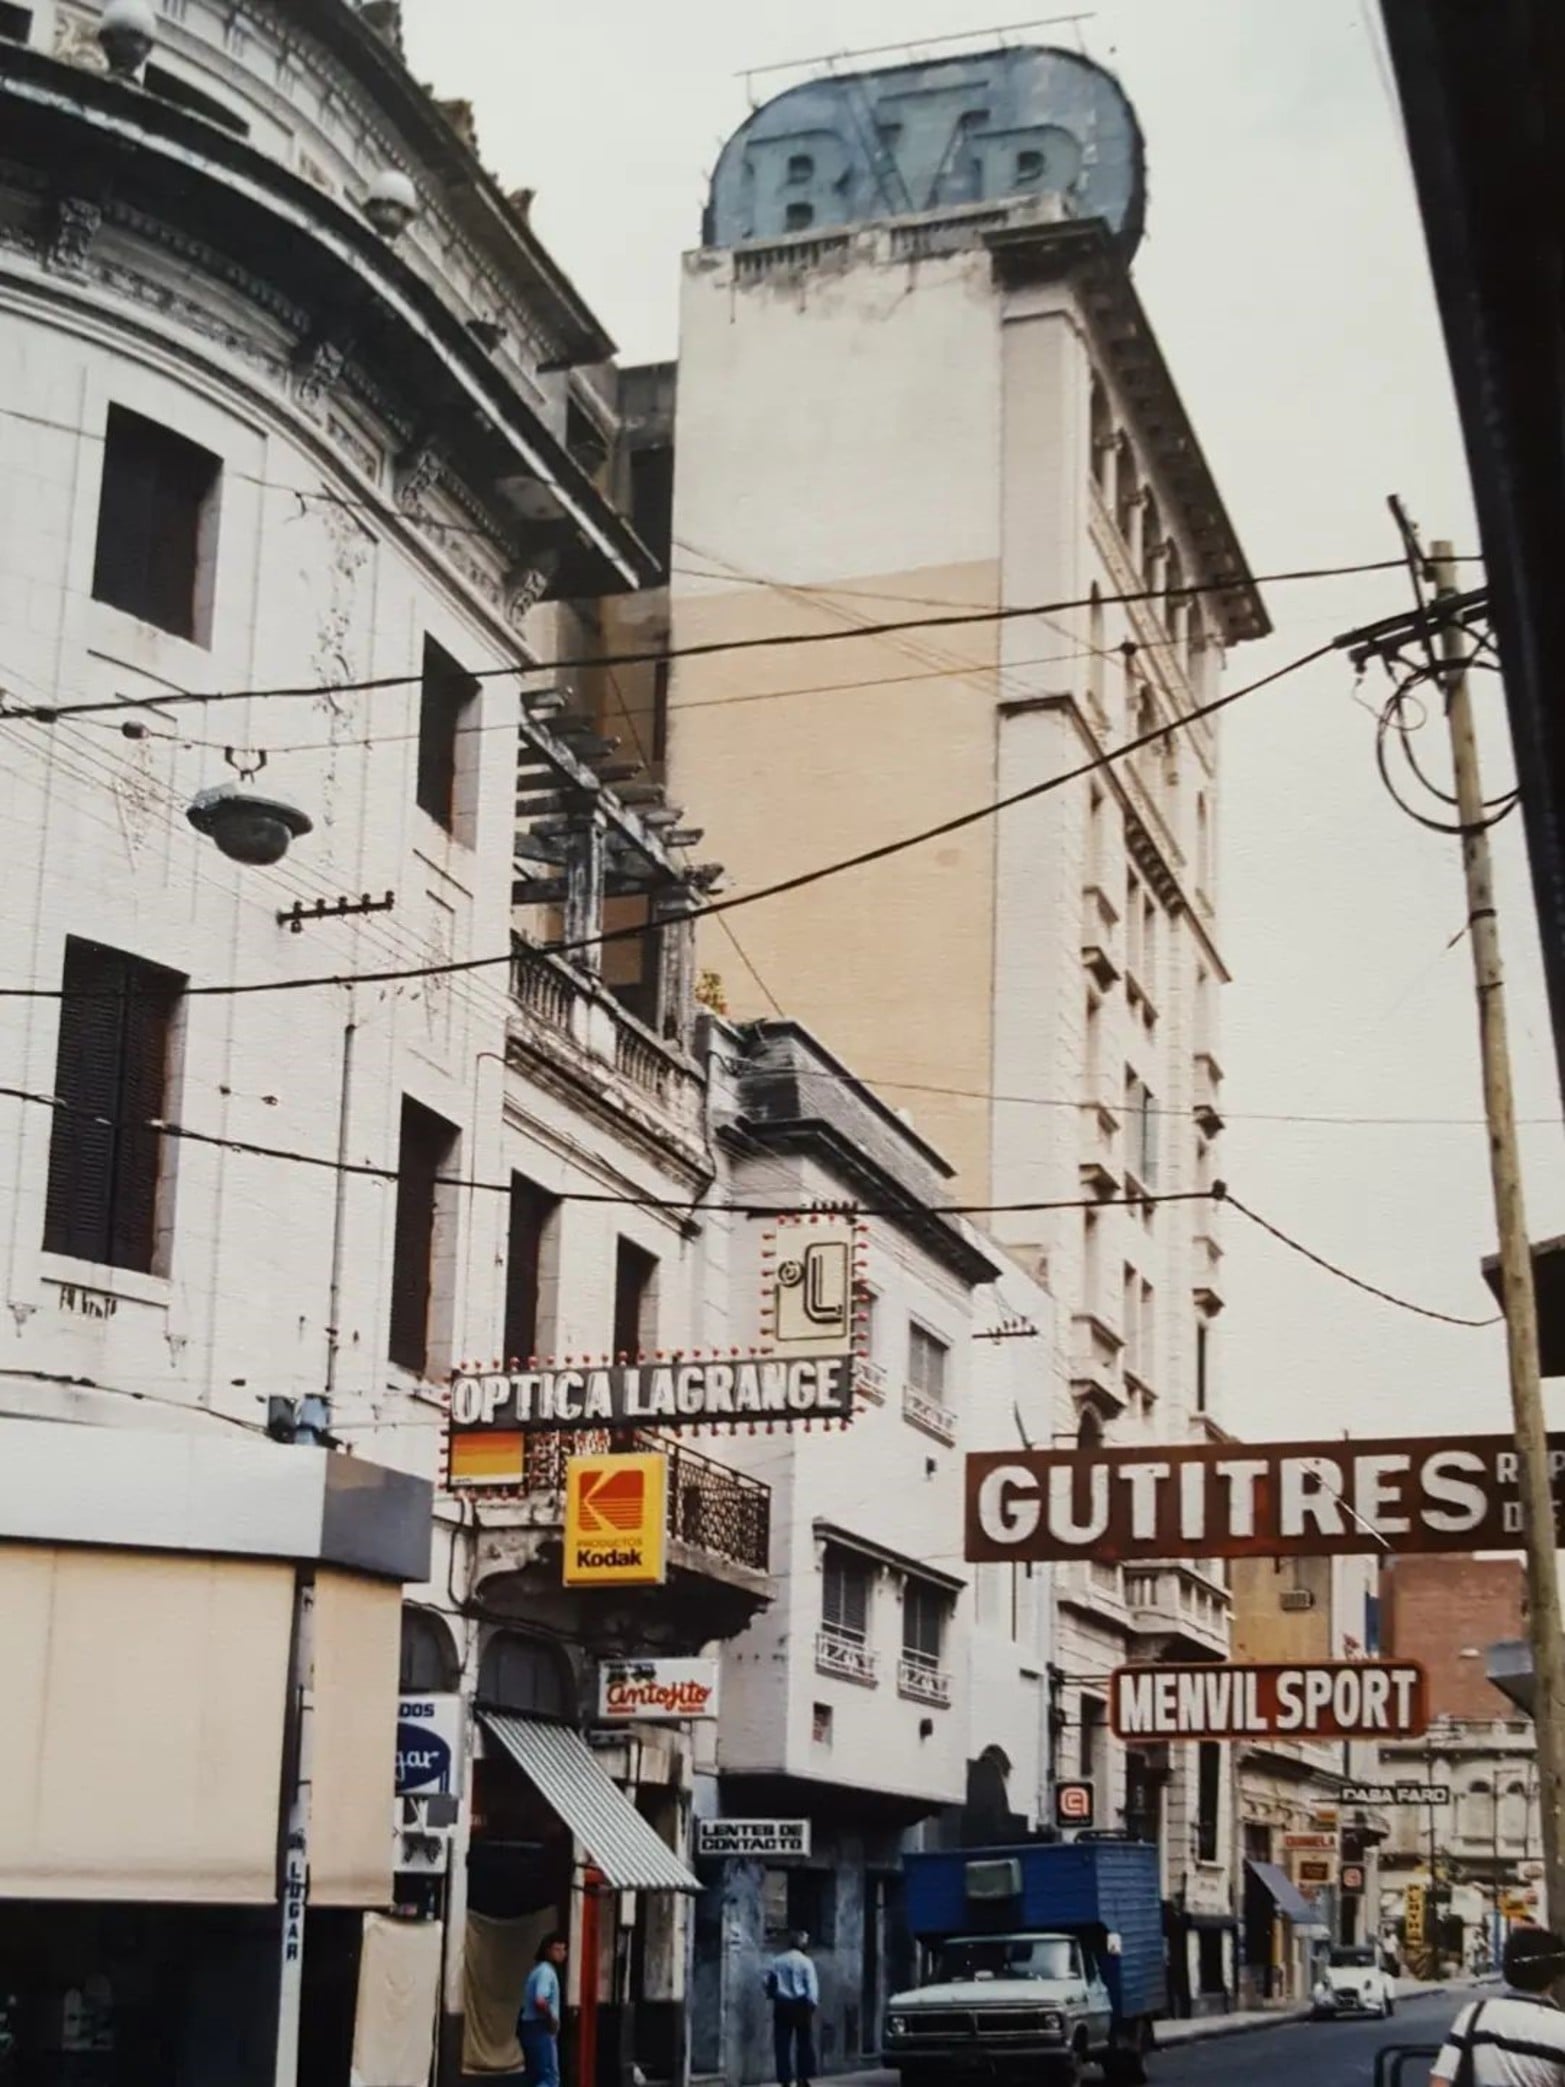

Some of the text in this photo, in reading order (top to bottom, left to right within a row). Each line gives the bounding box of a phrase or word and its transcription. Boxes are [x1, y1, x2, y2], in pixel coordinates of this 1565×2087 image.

[451, 1358, 843, 1425] OPTICA LAGRANGE
[977, 1451, 1487, 1545] GUTITRES
[577, 1549, 642, 1568] Kodak
[1119, 1669, 1417, 1734] MENVIL SPORT
[702, 1824, 803, 1837] LENTES DE
[702, 1839, 802, 1850] CONTACTO
